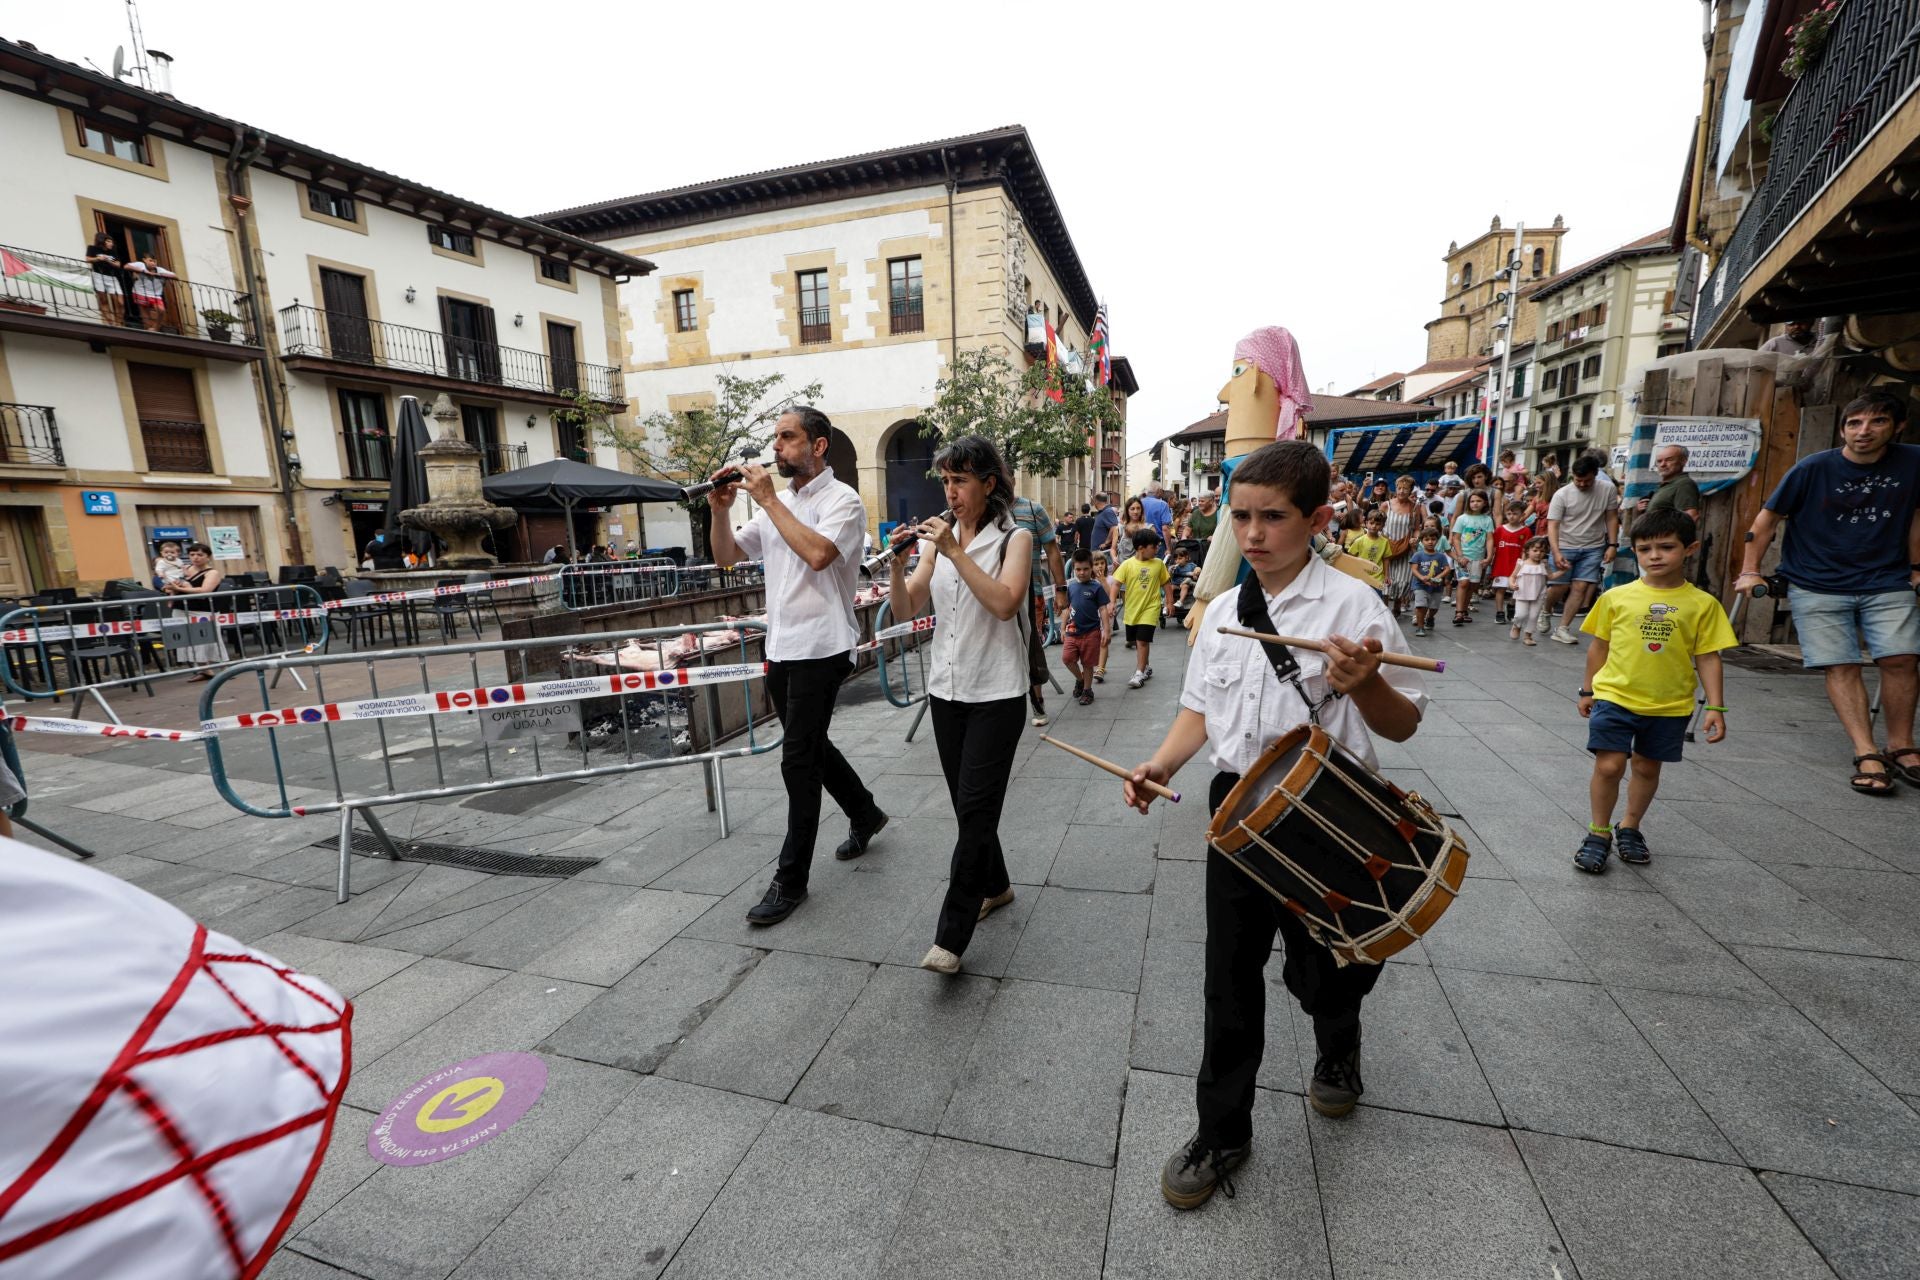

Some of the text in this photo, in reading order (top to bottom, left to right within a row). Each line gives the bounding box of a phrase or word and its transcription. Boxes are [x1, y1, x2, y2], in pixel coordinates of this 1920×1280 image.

[1659, 425, 1688, 434] MESEDEZ,
[1697, 424, 1724, 433] GELDITU
[1662, 435, 1674, 443] EDO
[1702, 450, 1710, 458] SE
[1710, 450, 1746, 458] DETENGAN
[1836, 510, 1892, 524] 1898
[541, 679, 593, 690] UDALTZAINGOA
[536, 686, 600, 698] POLICIA MUNICIPAL
[358, 697, 417, 710] UDALTZAINGOA
[352, 705, 426, 718] POLICIA MUNICIPAL
[492, 704, 571, 721] OIARTZUNGO
[513, 717, 552, 730] UDALA
[391, 1066, 463, 1111] ZERBITZUA
[441, 1122, 497, 1154] ARRETA
[412, 1148, 437, 1158] eta
